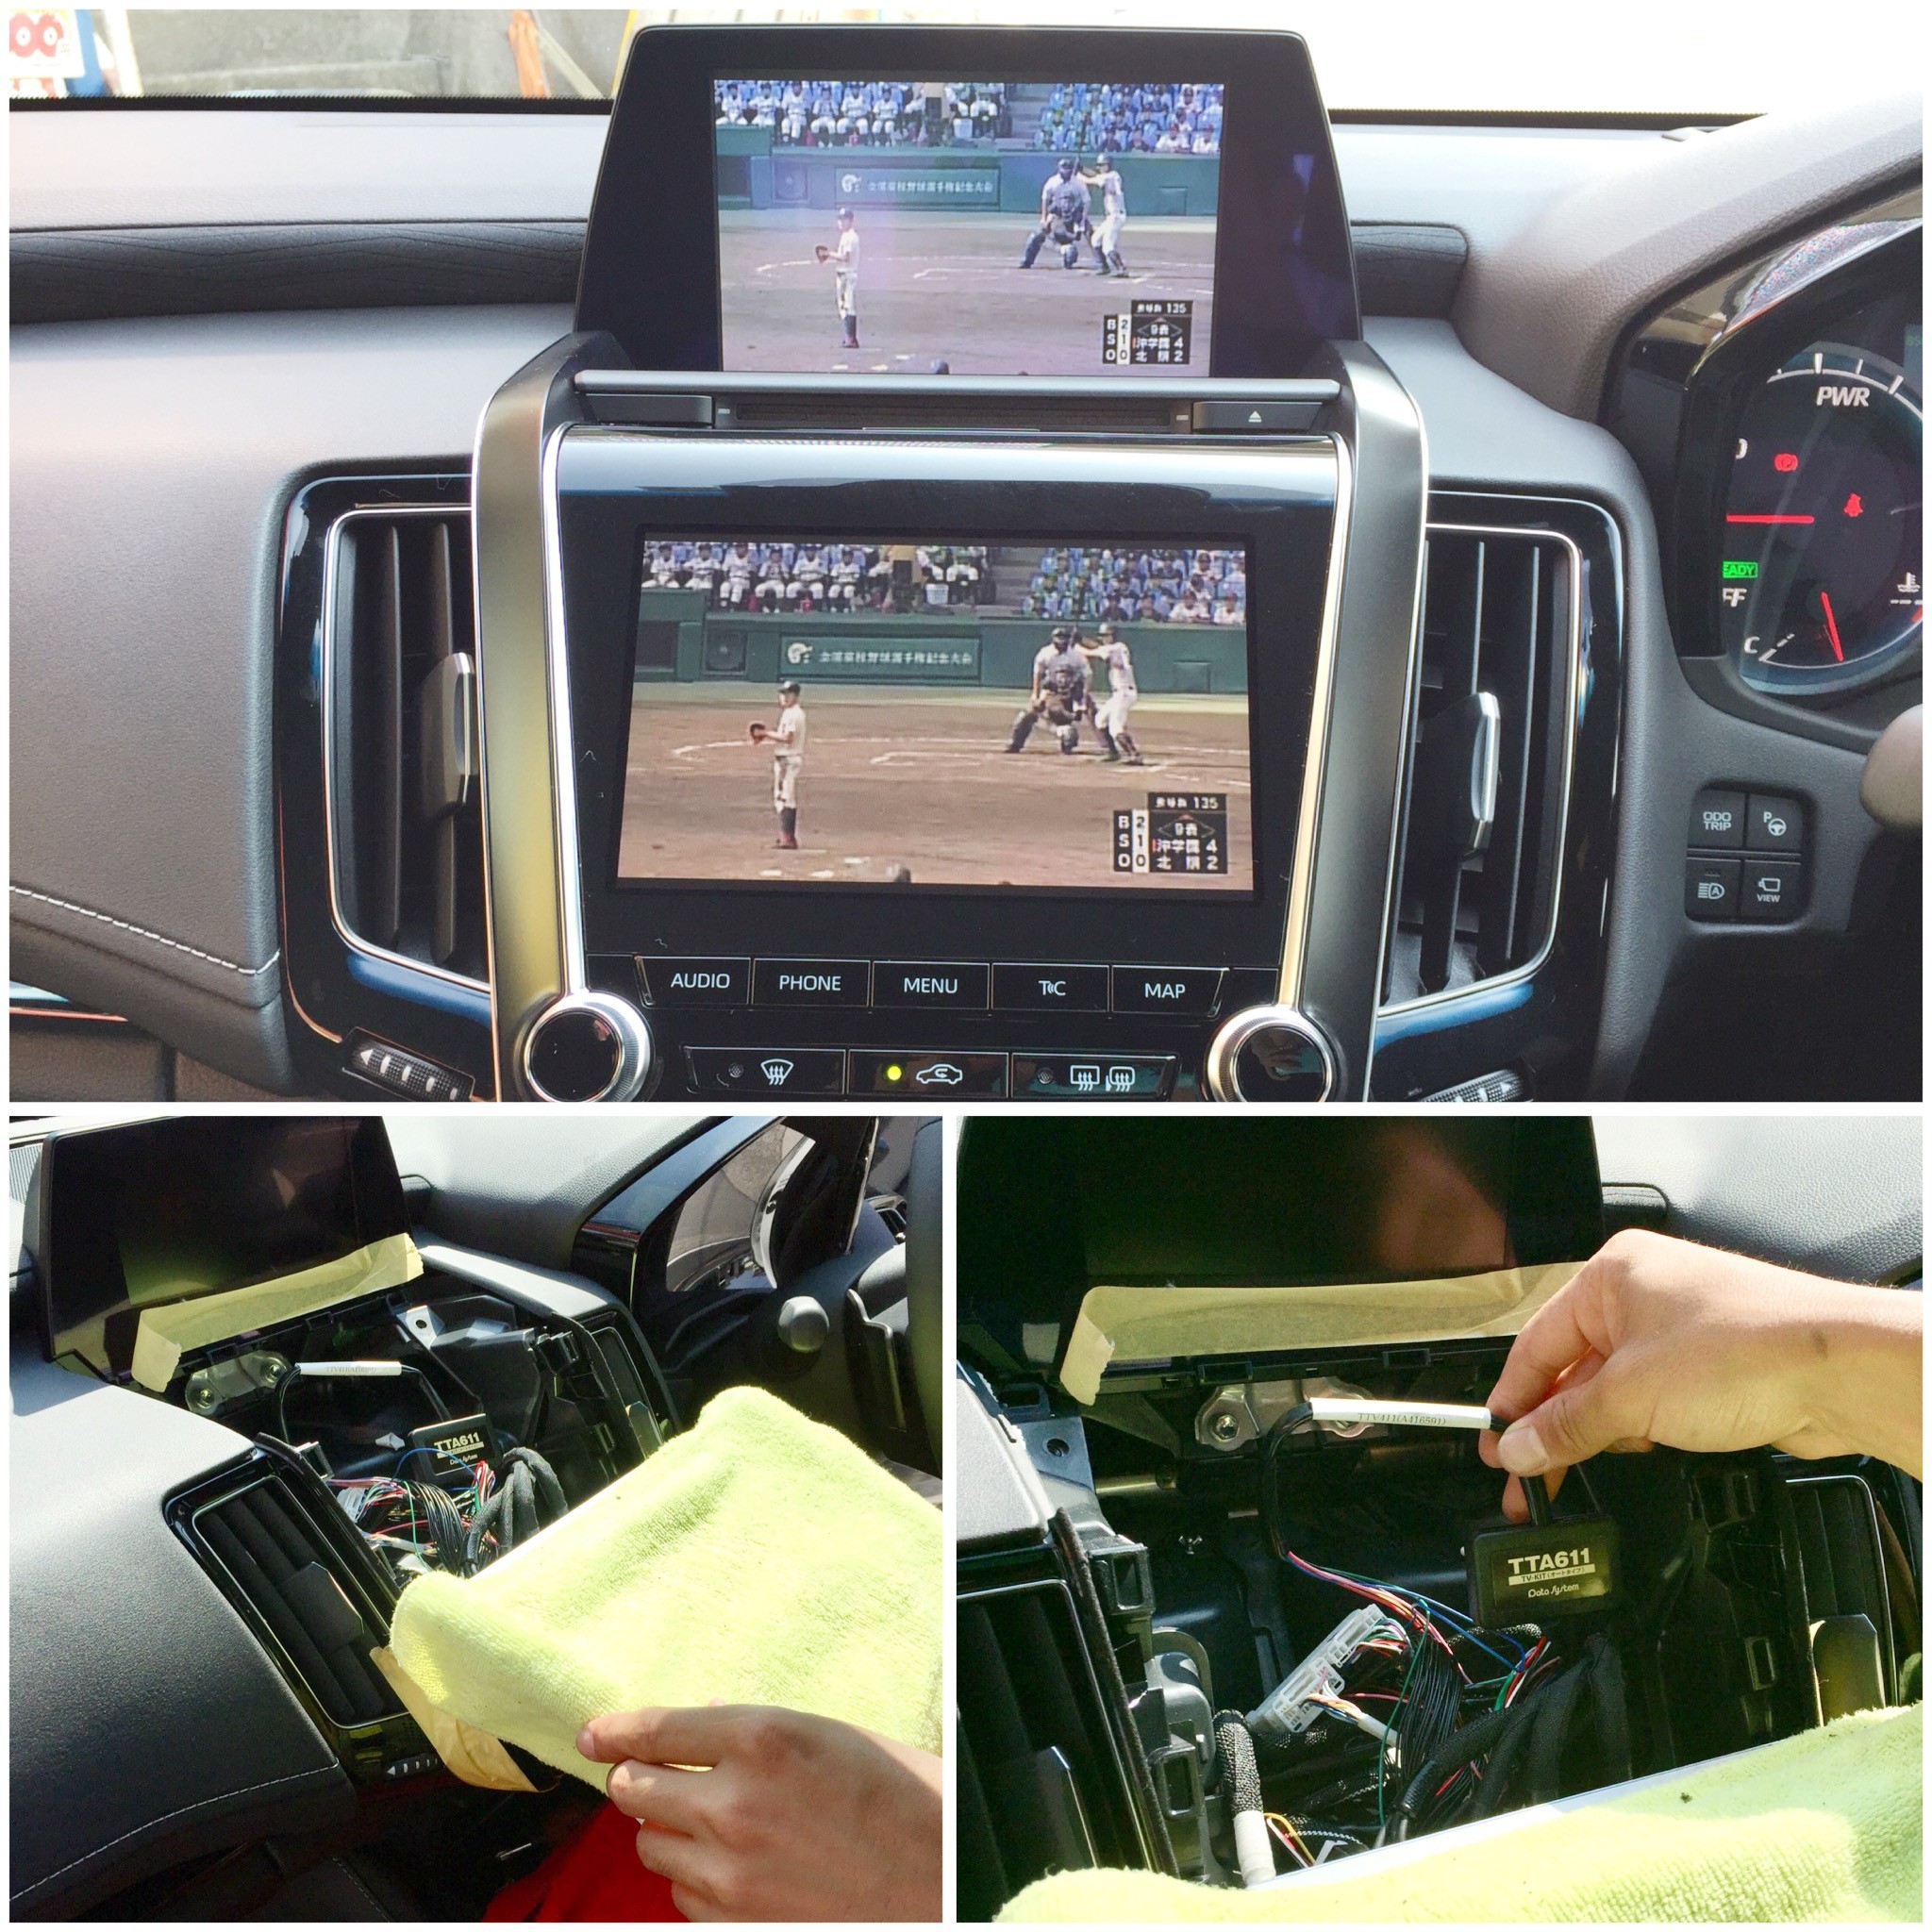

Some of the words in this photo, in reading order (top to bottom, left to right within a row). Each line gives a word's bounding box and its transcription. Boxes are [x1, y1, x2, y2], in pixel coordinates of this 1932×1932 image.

[1167, 303, 1187, 314] 135
[1107, 333, 1116, 345] S
[1174, 337, 1183, 349] 4
[1120, 350, 1127, 360] 0
[1174, 350, 1183, 362] 2
[1816, 386, 1870, 407] PWR
[1723, 564, 1756, 576] EADY
[1723, 588, 1747, 608] FF
[1744, 636, 1759, 654] C
[1193, 796, 1219, 809] 135
[1703, 811, 1732, 822] ODO
[1763, 811, 1773, 823] P
[1703, 821, 1732, 831] TRIP
[1118, 833, 1130, 847] S
[1206, 839, 1218, 854] 4
[1136, 854, 1146, 867] 0
[1207, 856, 1219, 871] 2
[1757, 893, 1781, 903] VIEW
[671, 973, 730, 989] AUDIO
[779, 974, 841, 991] PHONE
[904, 977, 958, 994] MENU
[1144, 982, 1186, 999] MAP
[434, 1432, 480, 1451] TTA611
[1507, 1547, 1591, 1574] TTA611
[1527, 1587, 1550, 1599] Data
[1550, 1583, 1580, 1596] System
